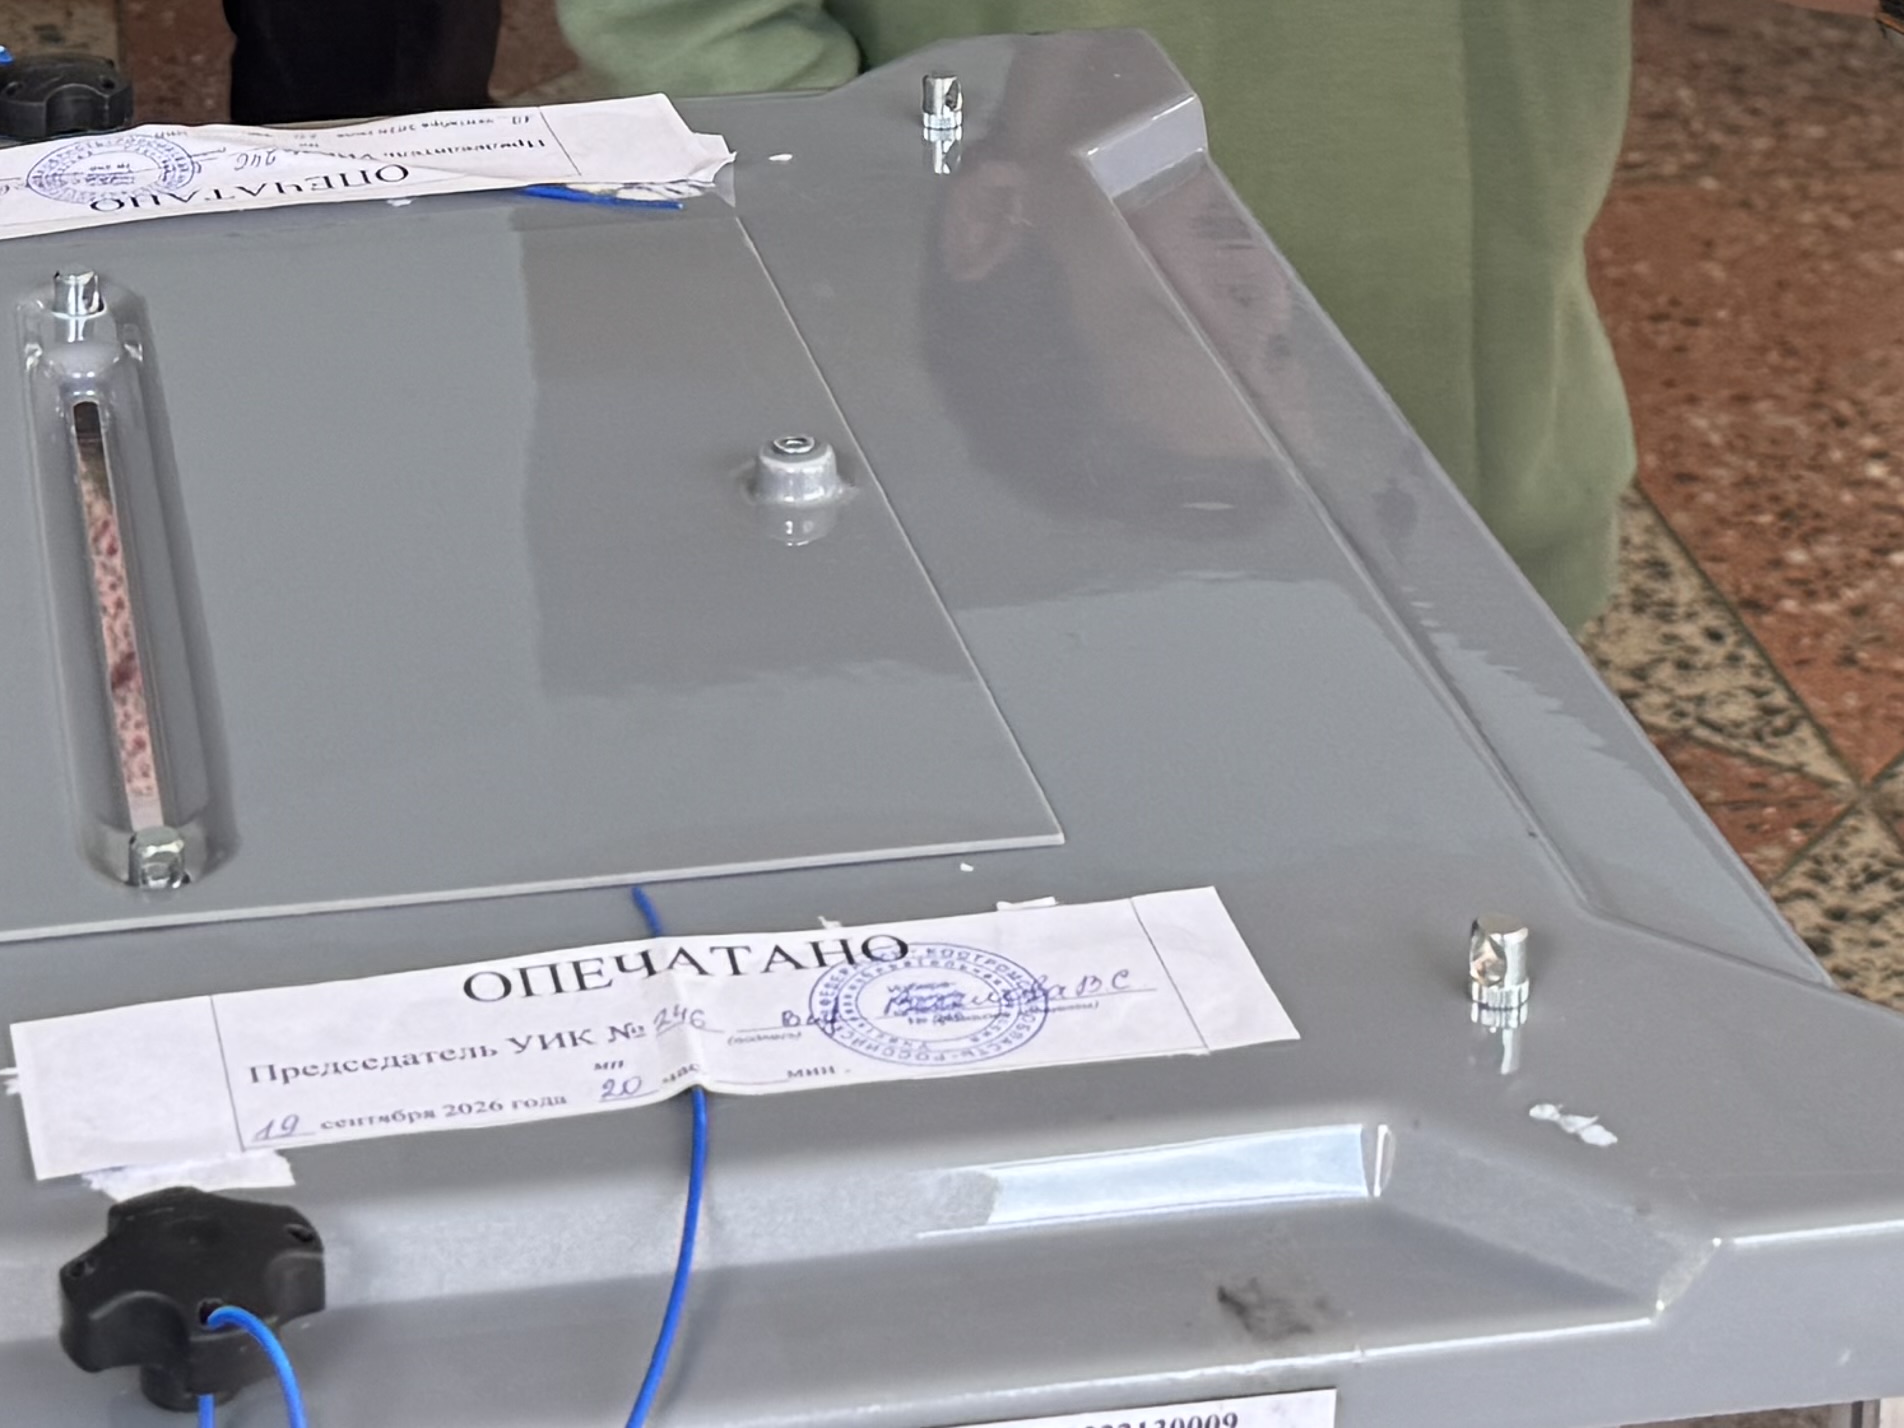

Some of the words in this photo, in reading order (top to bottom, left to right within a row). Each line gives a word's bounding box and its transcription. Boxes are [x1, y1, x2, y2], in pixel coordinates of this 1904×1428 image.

[89, 163, 409, 213] ОПЕЧАТАНО
[463, 934, 909, 1002] ОПЕЧАТАНО
[653, 1004, 707, 1032] 246
[249, 1044, 498, 1084] Председатель
[506, 1028, 596, 1054] УИК
[607, 1022, 646, 1043] №
[320, 1107, 437, 1131] сентября
[442, 1099, 504, 1118] 2026
[510, 1095, 568, 1111] года
